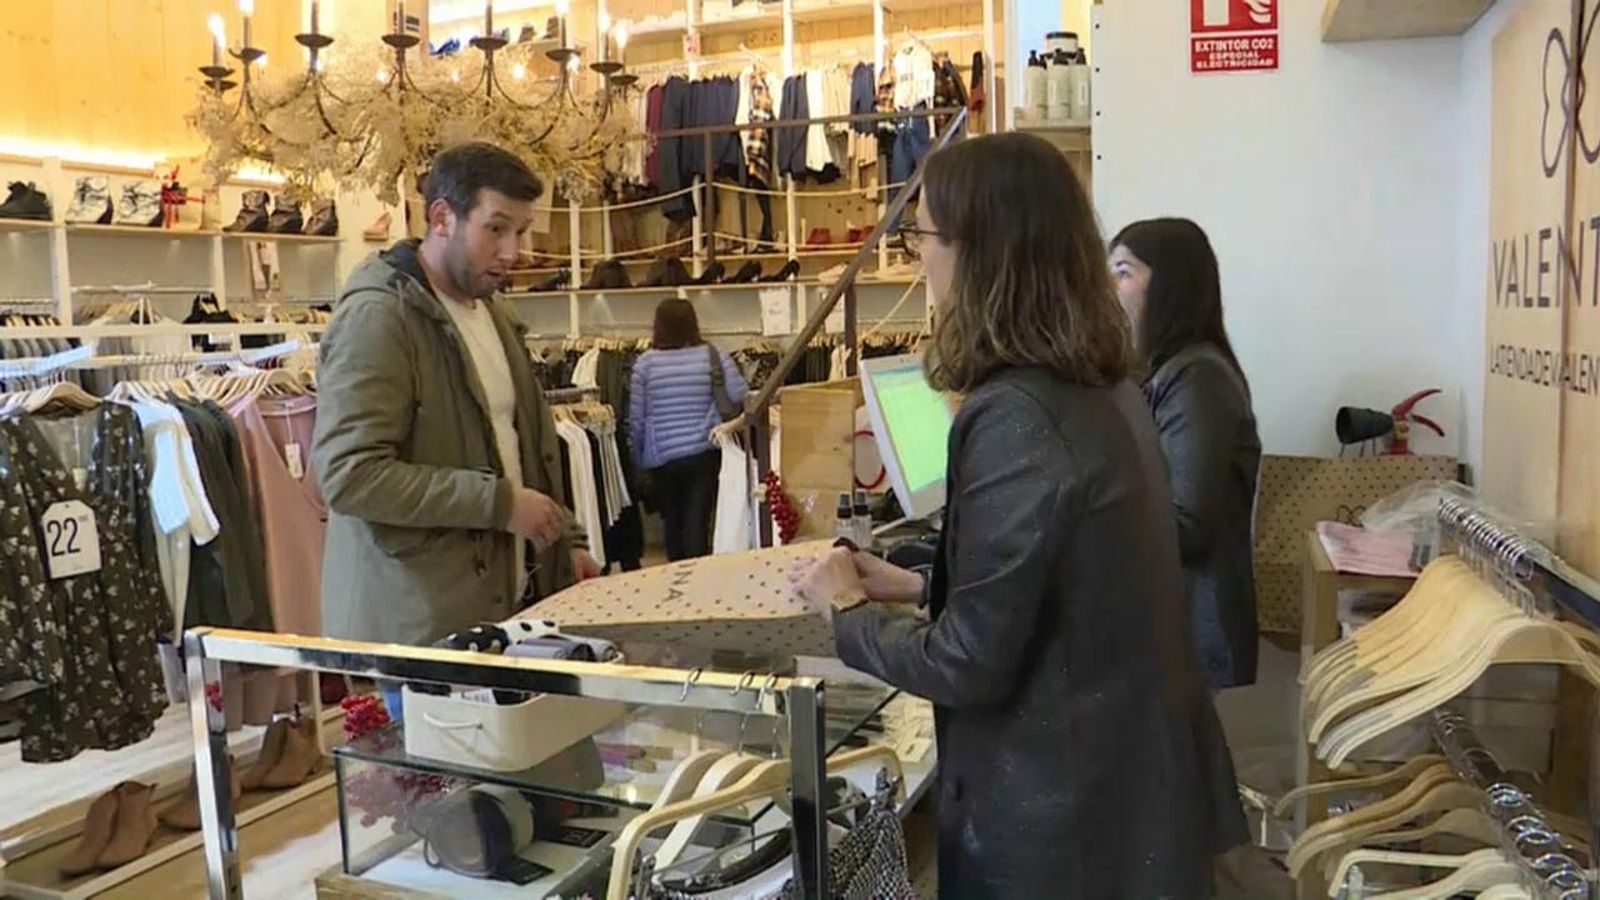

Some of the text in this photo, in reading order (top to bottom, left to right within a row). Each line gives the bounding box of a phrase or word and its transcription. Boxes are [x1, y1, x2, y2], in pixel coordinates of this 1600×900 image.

[1195, 38, 1274, 52] EXTINTOR CO2
[1209, 51, 1260, 60] ESPECIAL
[1196, 58, 1274, 69] ELECTRICIDAD
[47, 517, 81, 557] 22
